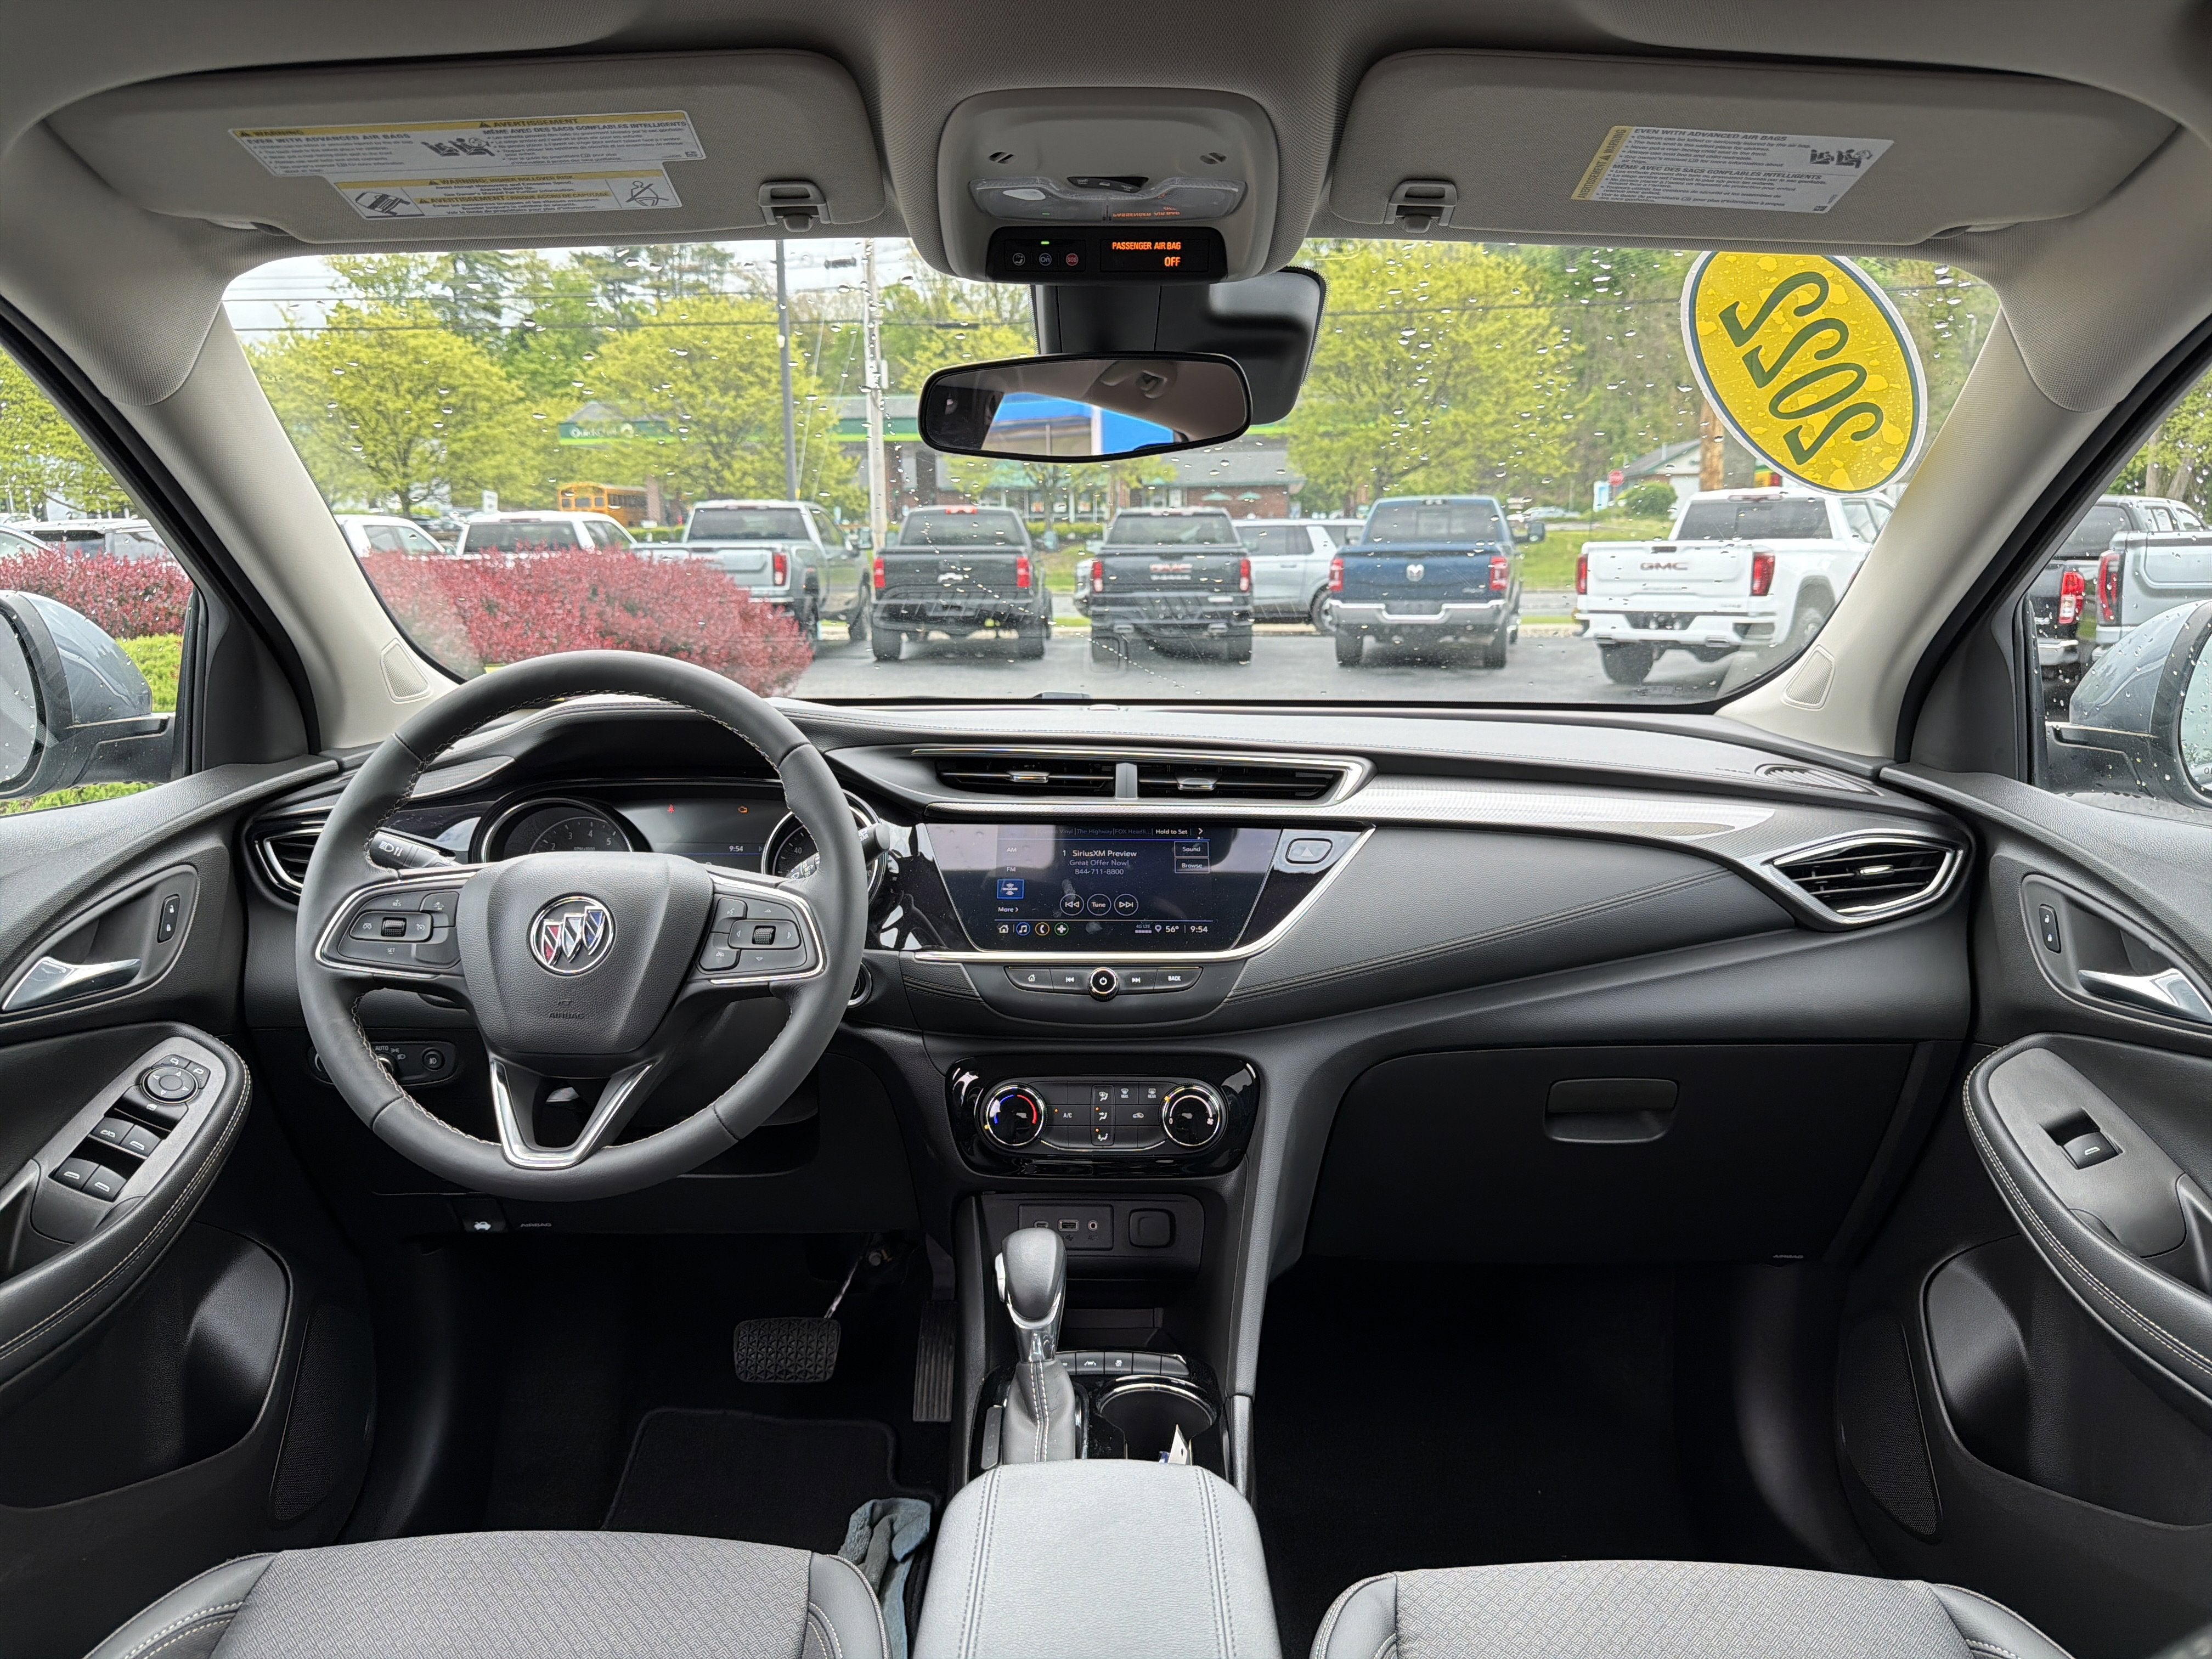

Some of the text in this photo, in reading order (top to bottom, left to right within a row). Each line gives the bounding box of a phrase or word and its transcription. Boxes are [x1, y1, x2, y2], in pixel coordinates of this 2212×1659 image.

[494, 119, 578, 127] AVERTISSEMENT
[1604, 129, 1626, 153] WARNING
[1577, 161, 1606, 199] AVERTISSEMENT
[1763, 172, 1822, 180] INTELLIGENTS
[1112, 241, 1181, 250] PASSENGER AIR BAG
[1164, 256, 1181, 267] OFF
[1718, 271, 1884, 465] 2022
[1640, 562, 1688, 571] GMC
[606, 837, 611, 845] 5
